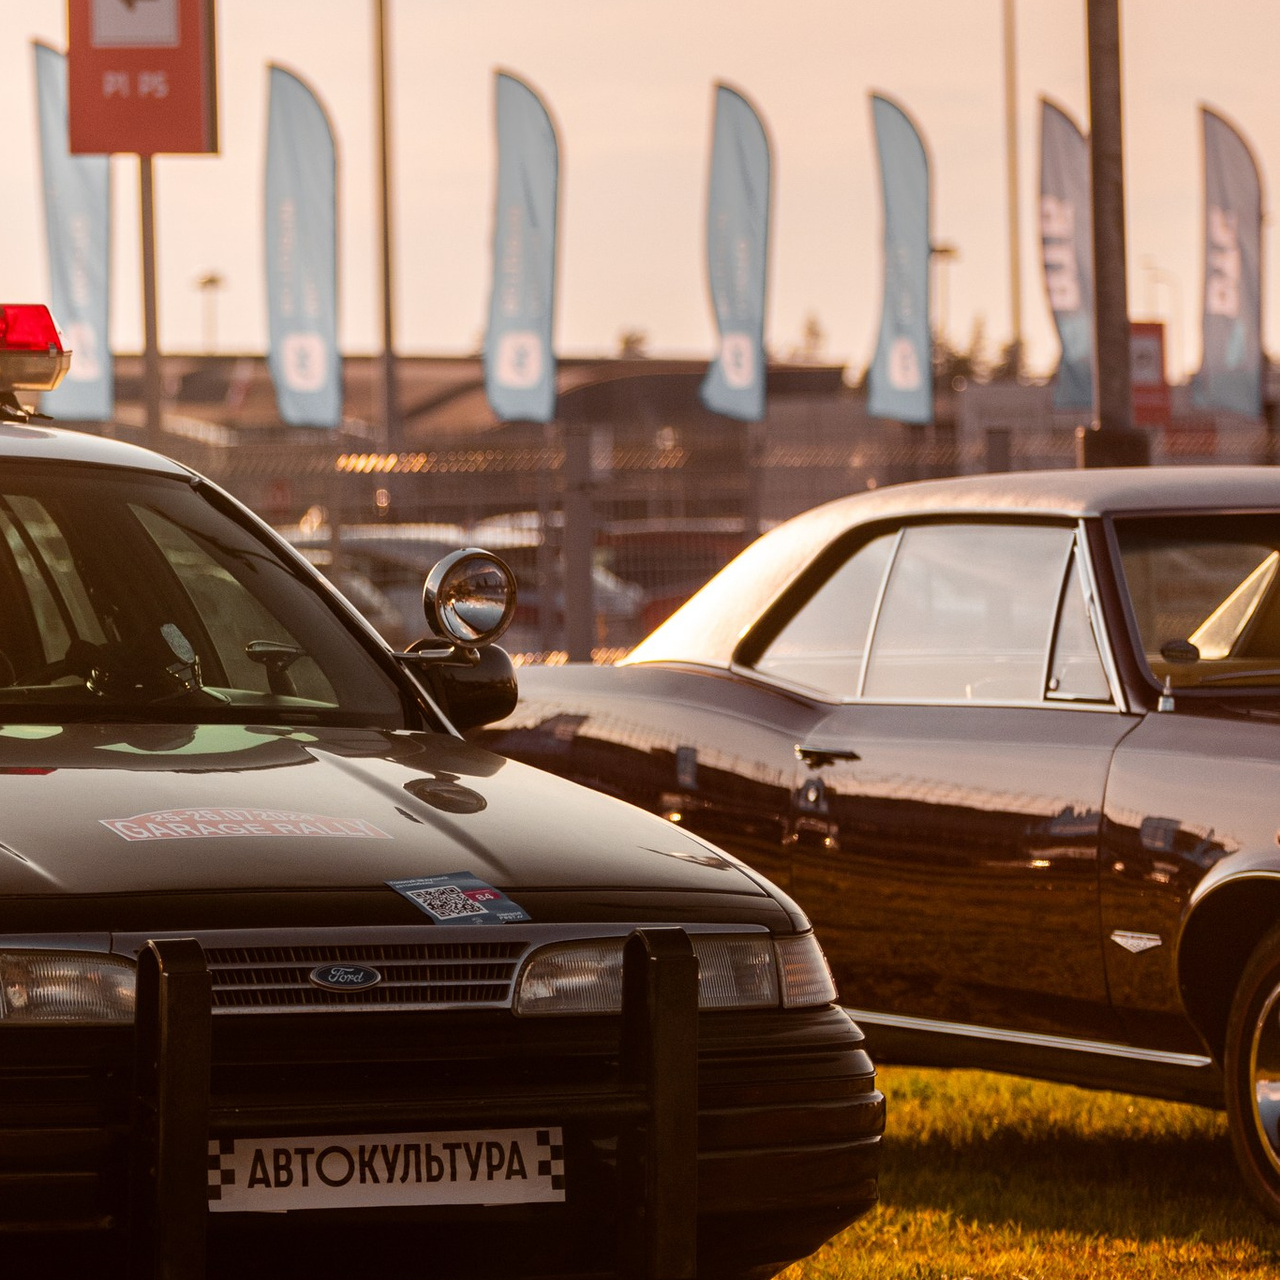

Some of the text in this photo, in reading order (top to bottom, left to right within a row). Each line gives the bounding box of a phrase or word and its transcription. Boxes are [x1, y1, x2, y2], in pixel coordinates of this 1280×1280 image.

[114, 820, 376, 839] GARAGE RALLY
[475, 893, 494, 901] 84
[328, 967, 364, 982] Ford
[247, 1140, 528, 1189] АВТОКУЛЬТУРА
